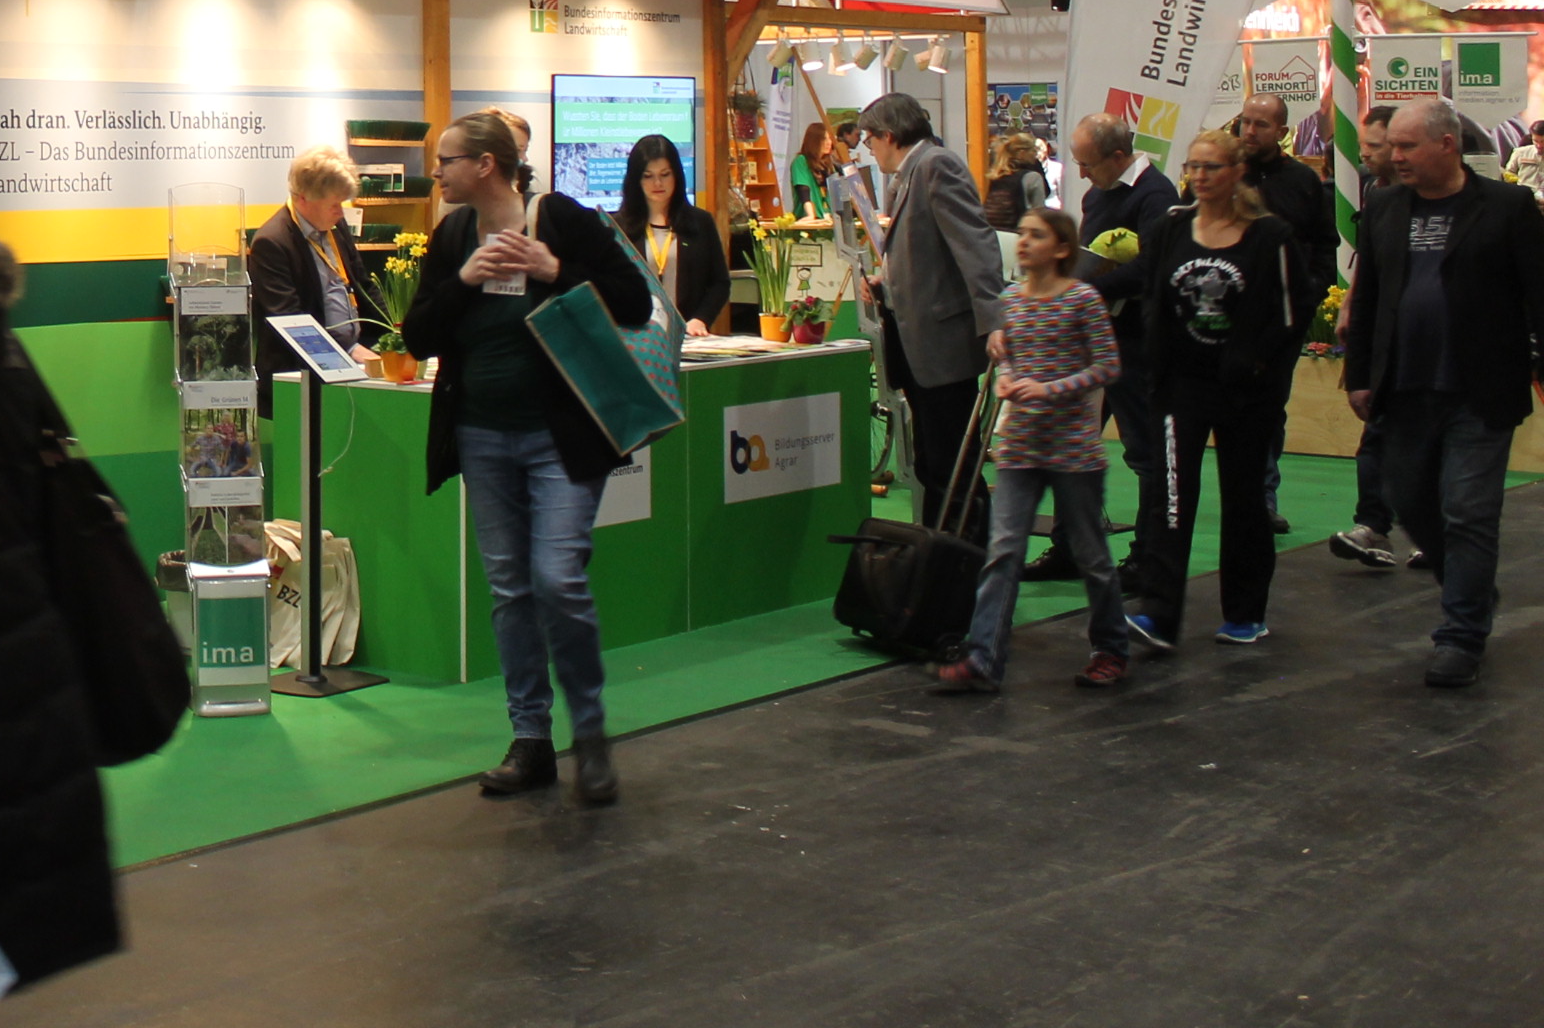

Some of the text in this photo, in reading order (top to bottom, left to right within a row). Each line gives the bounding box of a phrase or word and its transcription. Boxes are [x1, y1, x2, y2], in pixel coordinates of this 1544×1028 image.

[564, 5, 681, 23] Bundesinformationszentrum
[565, 24, 627, 36] Landwirtschaft
[1256, 73, 1289, 81] FORUM
[1414, 67, 1438, 77] EIN
[1256, 82, 1306, 91] LERNORT
[1375, 80, 1438, 90] SICHTEN
[26, 110, 70, 129] dran.
[75, 109, 165, 129] Verlässlich.
[170, 111, 266, 134] Unabhängig.
[40, 141, 69, 160] Das
[75, 141, 294, 160] Bundesinformationszentrum
[775, 432, 834, 452] Bildungsserver
[775, 456, 798, 471] Agrar
